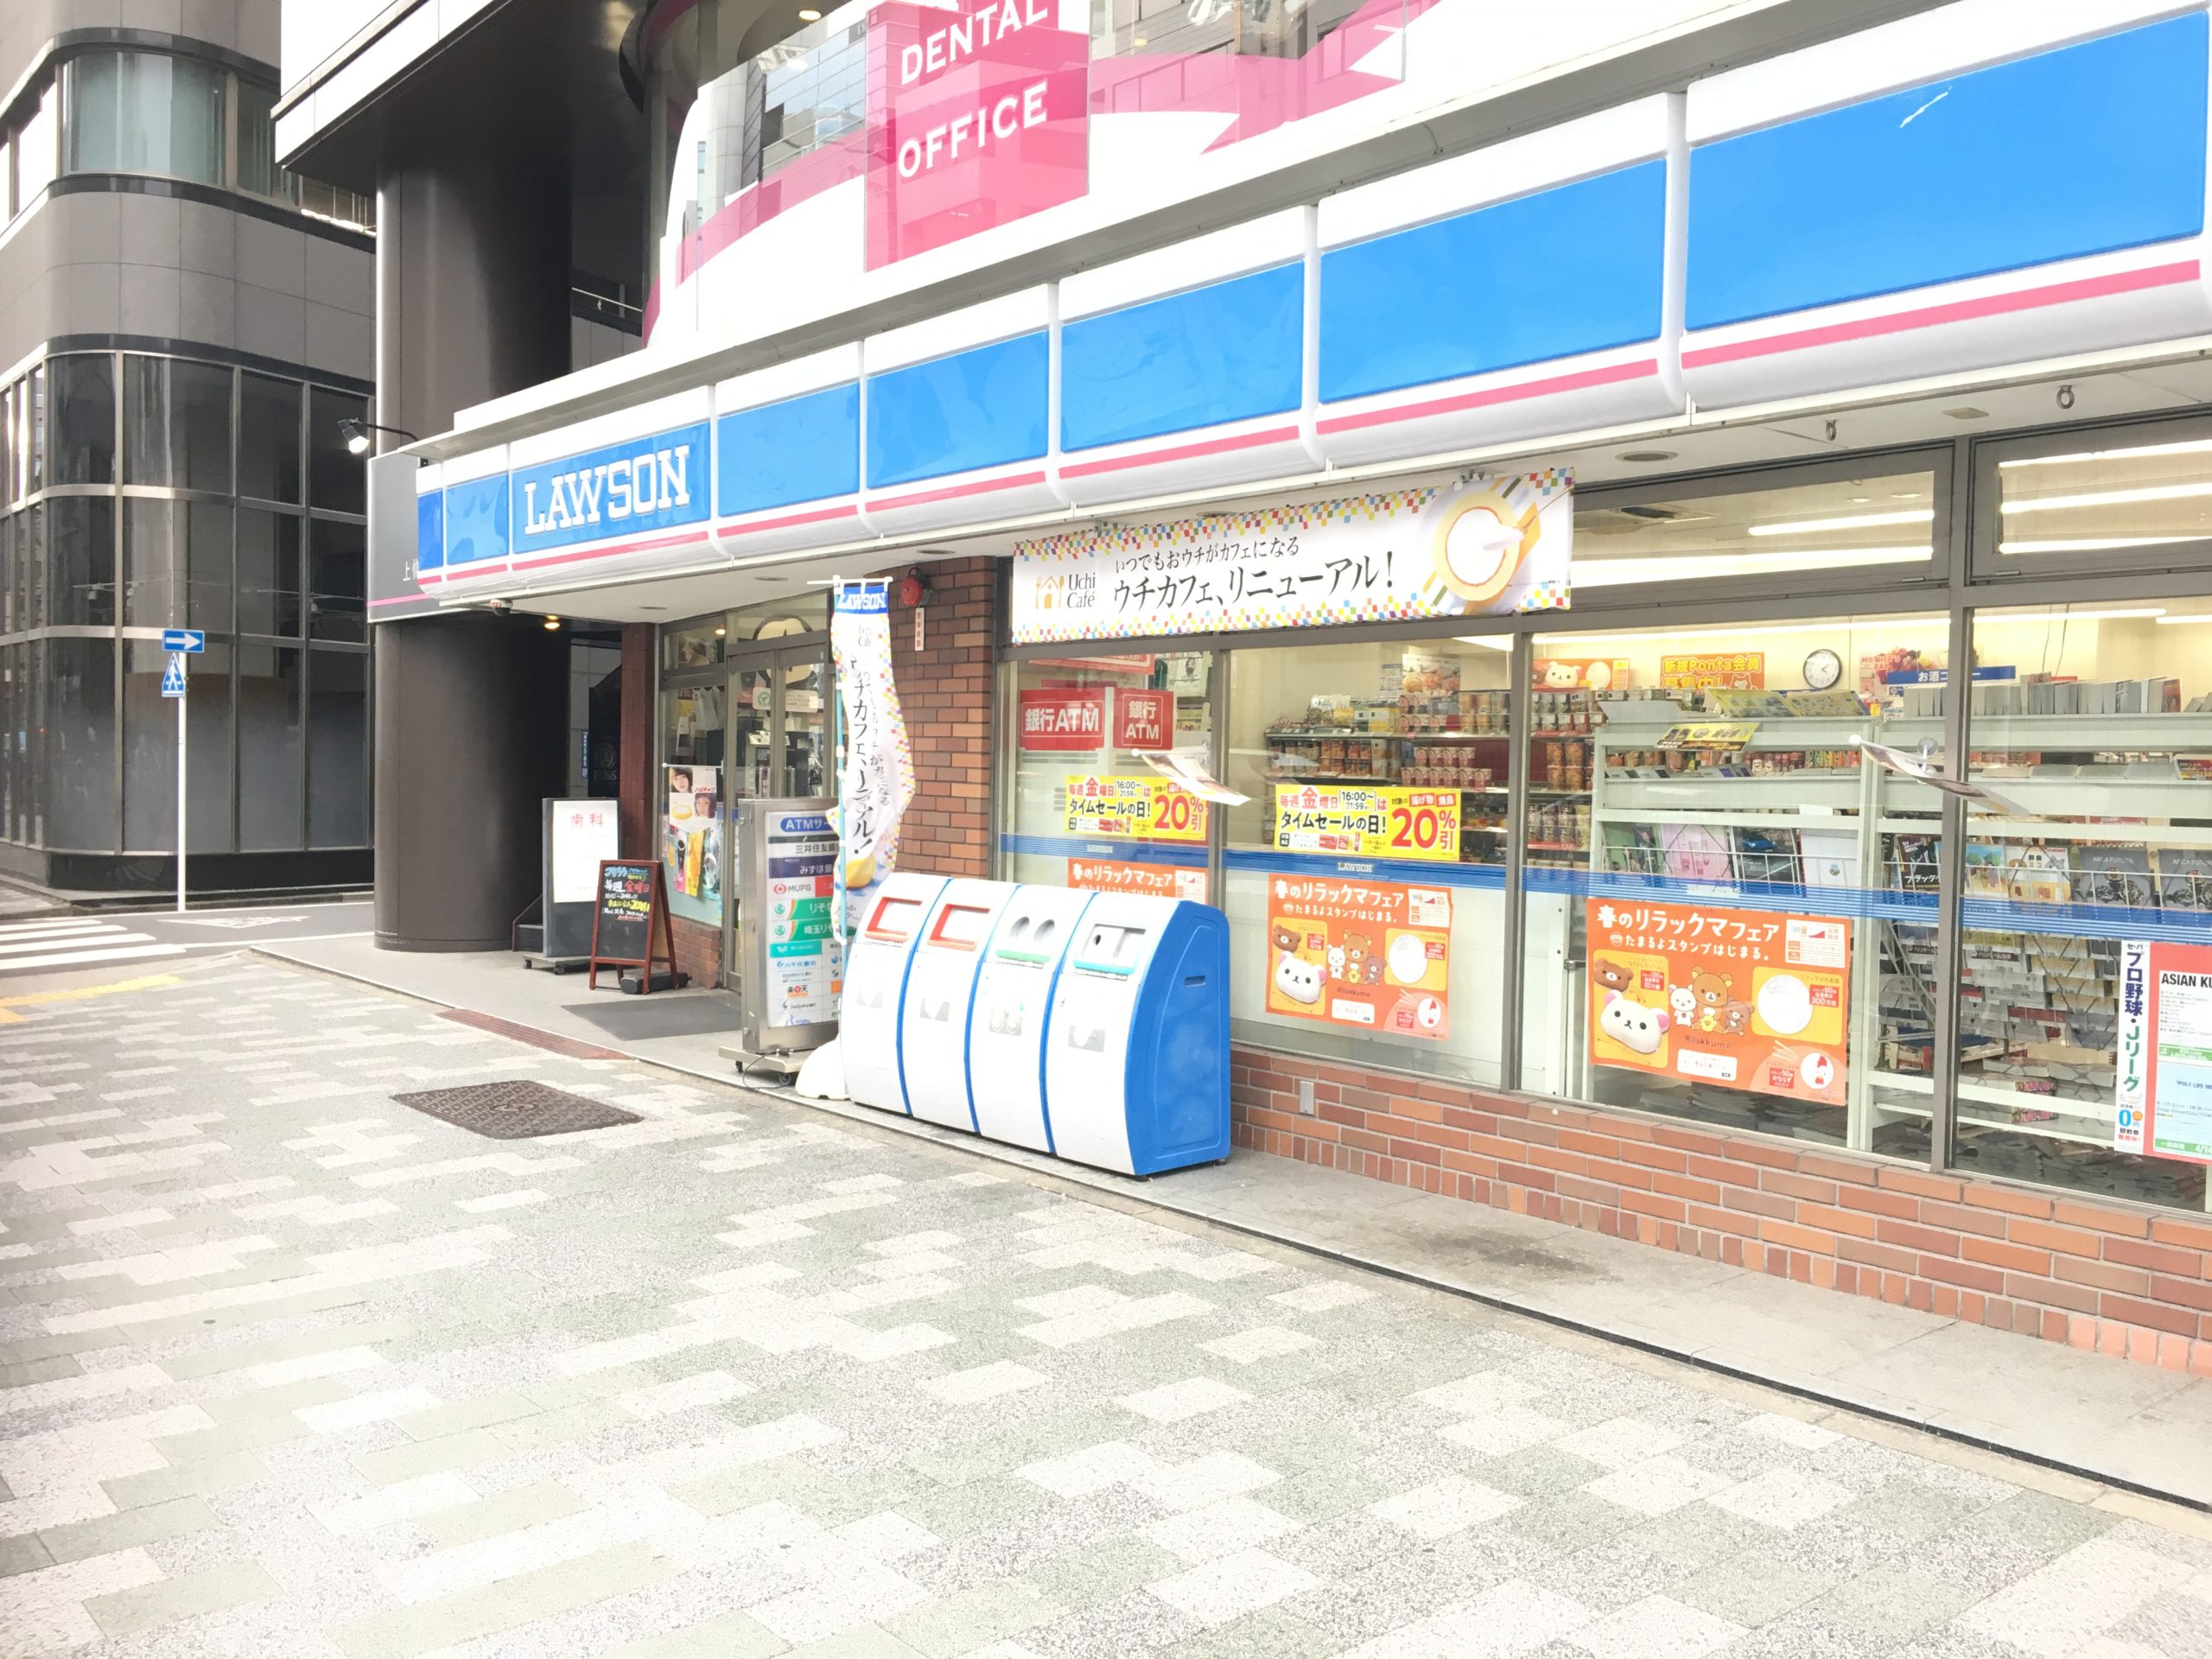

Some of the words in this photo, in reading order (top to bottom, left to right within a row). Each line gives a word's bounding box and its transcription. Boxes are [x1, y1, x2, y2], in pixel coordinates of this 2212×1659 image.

[901, 0, 1048, 85] DENTAL
[898, 80, 1047, 178] OFFICE
[524, 444, 690, 536] LAWSON
[1116, 536, 1300, 574] いつでもおウチがカフェになる
[1068, 572, 1096, 591] Uchi
[836, 592, 887, 610] LAWSON
[1067, 590, 1096, 609] Café
[1664, 655, 1760, 674] 新規Ponta会員
[1025, 707, 1099, 733] 銀行ATM
[1128, 700, 1157, 720] 銀行
[1125, 723, 1159, 740] ATM
[570, 813, 604, 828] 歯科
[1281, 810, 1386, 835] タイムセールの日!
[1072, 862, 1173, 887] 春のリラックマフェア
[1338, 862, 1372, 873] LAWSON
[1274, 879, 1404, 907] 春のリラックマフェア
[1597, 905, 1780, 942] 春のリラックマフェア
[2161, 973, 2196, 987] ASIAN
[1685, 1035, 1732, 1049] Rilakkuma
